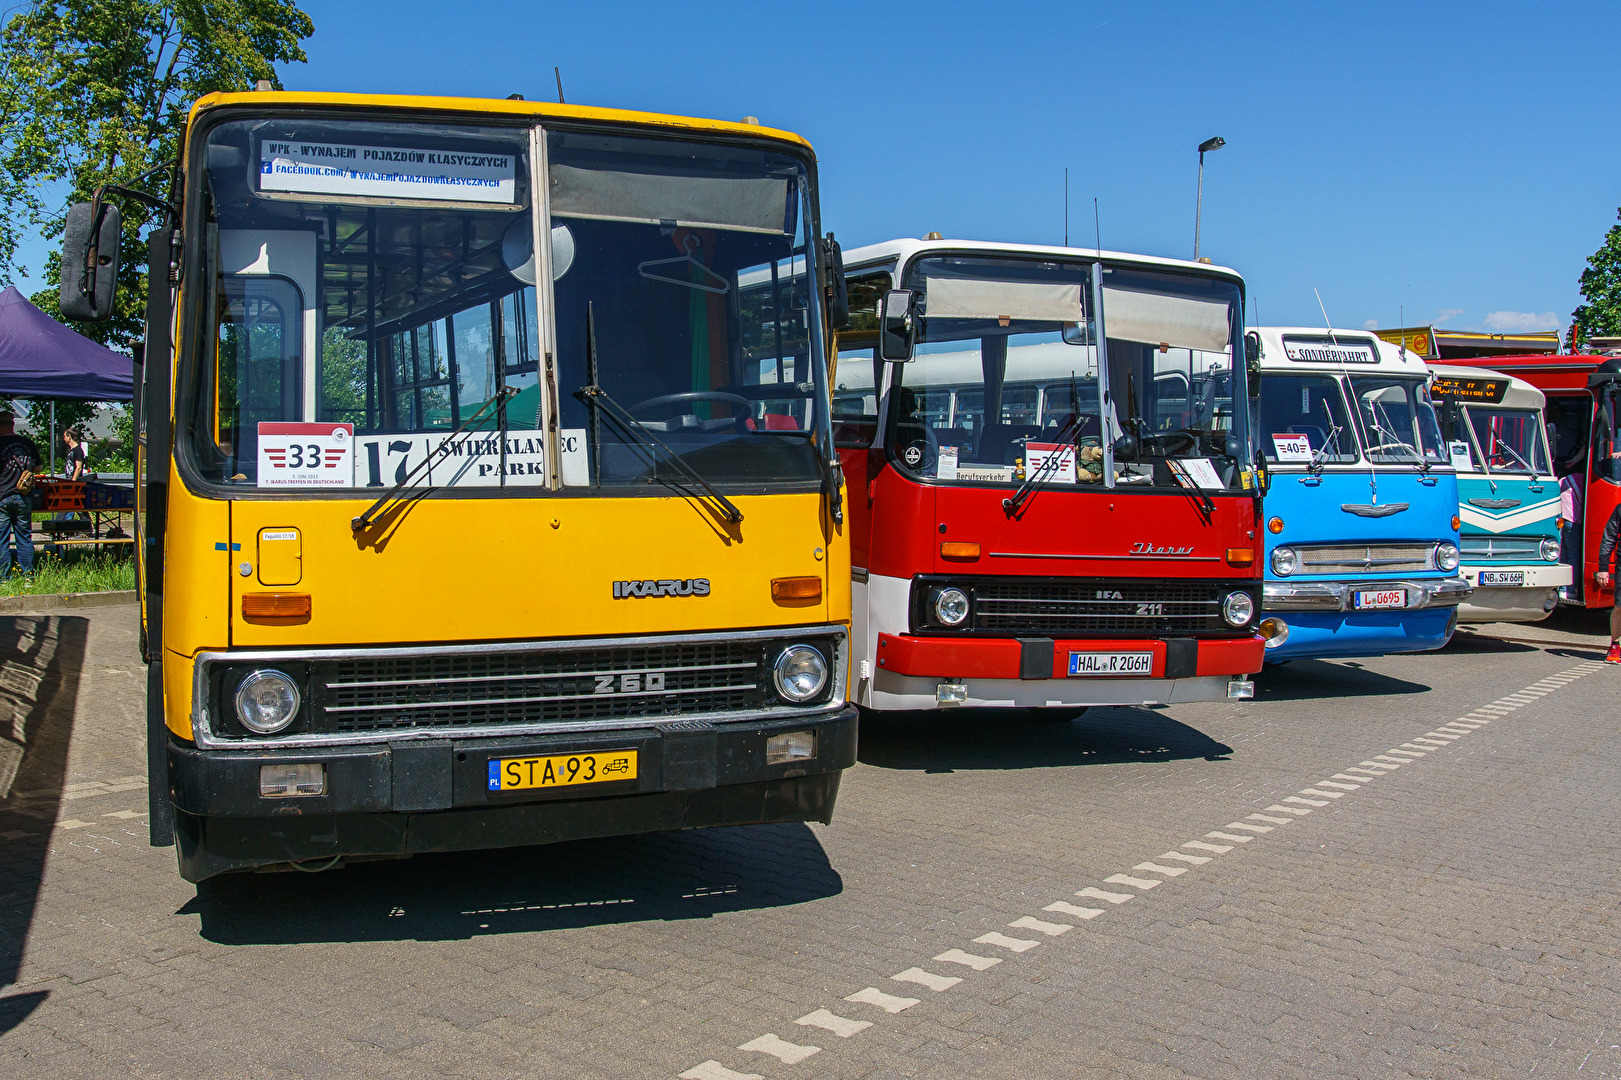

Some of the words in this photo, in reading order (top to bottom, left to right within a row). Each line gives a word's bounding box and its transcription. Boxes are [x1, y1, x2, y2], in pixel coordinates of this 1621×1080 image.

[269, 143, 290, 155] WPK
[301, 145, 356, 159] WYNAJEM
[364, 149, 425, 163] POJAZDÓW
[428, 153, 508, 168] KLASYCZNYCH
[1298, 348, 1368, 362] SONDERFAHRT
[1286, 443, 1300, 453] 40
[288, 444, 321, 468] 33
[364, 440, 413, 487] 17
[1042, 456, 1059, 471] 35
[478, 461, 543, 477] PARK
[956, 472, 1005, 481] Berufsverkehr
[1129, 542, 1194, 555] Ikarus
[1484, 573, 1494, 582] NB
[1499, 573, 1509, 582] SW
[1510, 573, 1523, 582] 66H
[612, 578, 711, 600] IKARUS
[1095, 590, 1123, 600] IFA
[1365, 593, 1371, 605] L
[1377, 591, 1400, 604] 0695
[1136, 603, 1163, 616] Z11
[1077, 656, 1101, 671] HAL
[1109, 656, 1118, 671] R
[1120, 656, 1149, 671] 206H
[594, 672, 665, 694] Z60
[490, 778, 500, 786] PL
[506, 759, 556, 787] STA
[566, 756, 596, 782] 93
